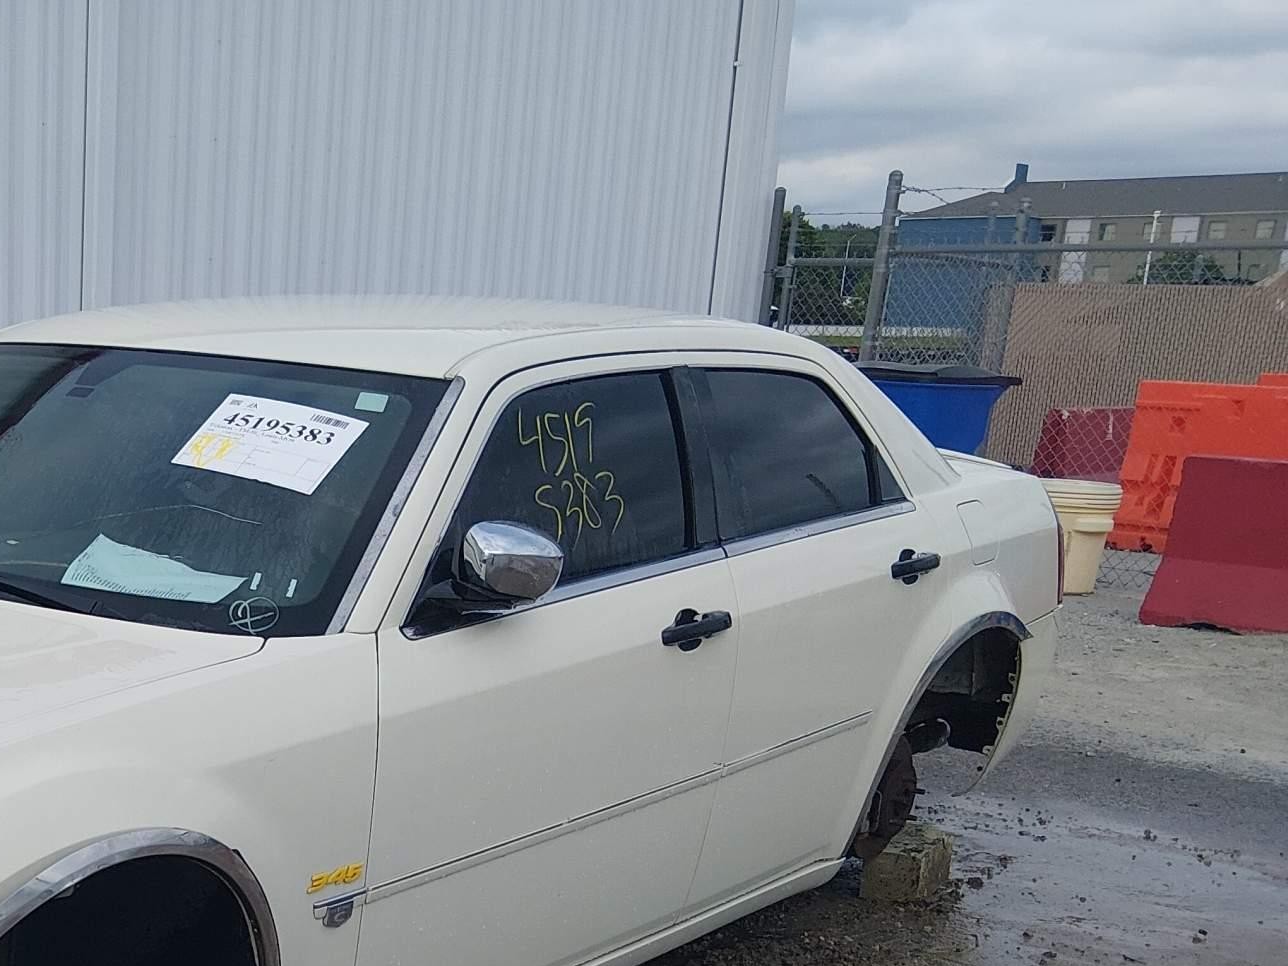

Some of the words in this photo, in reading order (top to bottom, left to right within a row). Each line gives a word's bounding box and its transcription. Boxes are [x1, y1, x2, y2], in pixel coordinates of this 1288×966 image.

[223, 412, 336, 446] 45195383
[518, 402, 596, 477] 4519
[535, 471, 624, 550] 5383
